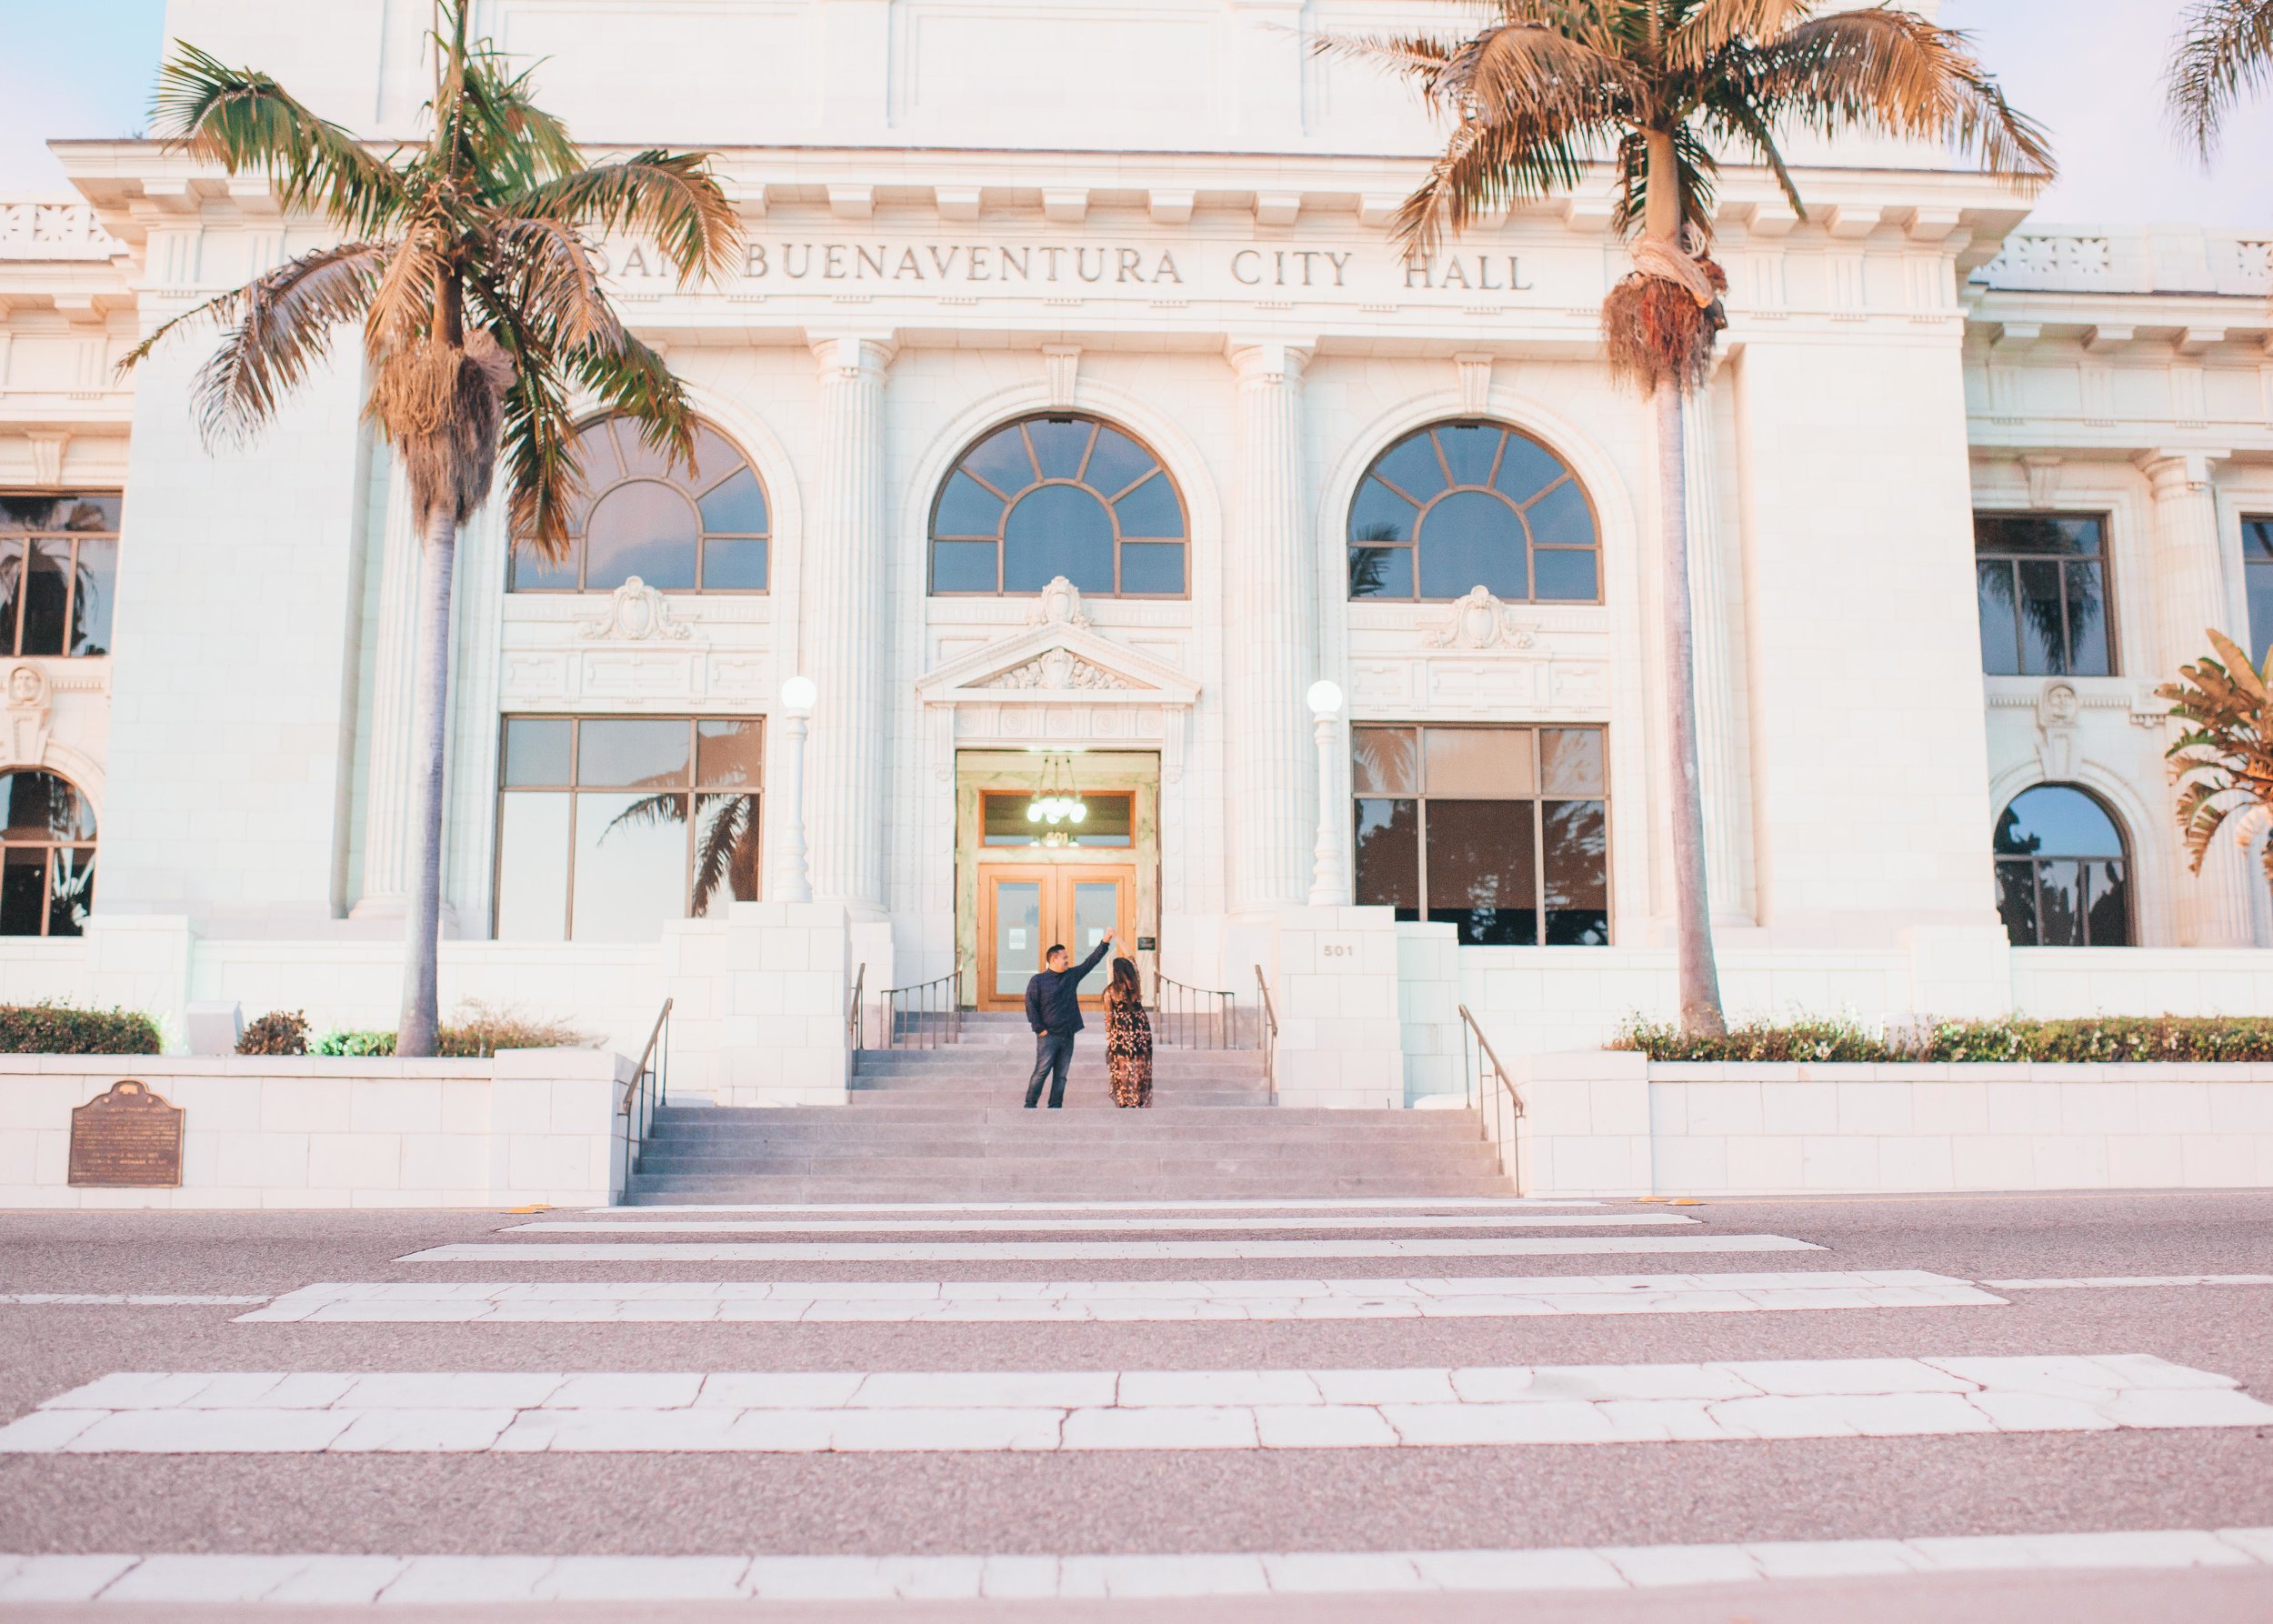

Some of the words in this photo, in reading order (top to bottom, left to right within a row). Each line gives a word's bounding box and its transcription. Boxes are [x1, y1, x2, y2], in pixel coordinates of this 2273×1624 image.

[743, 243, 1184, 283] BUENAVENTURA
[1230, 249, 1353, 286] CITY
[1403, 253, 1533, 290] HALL
[1323, 945, 1353, 957] 501
